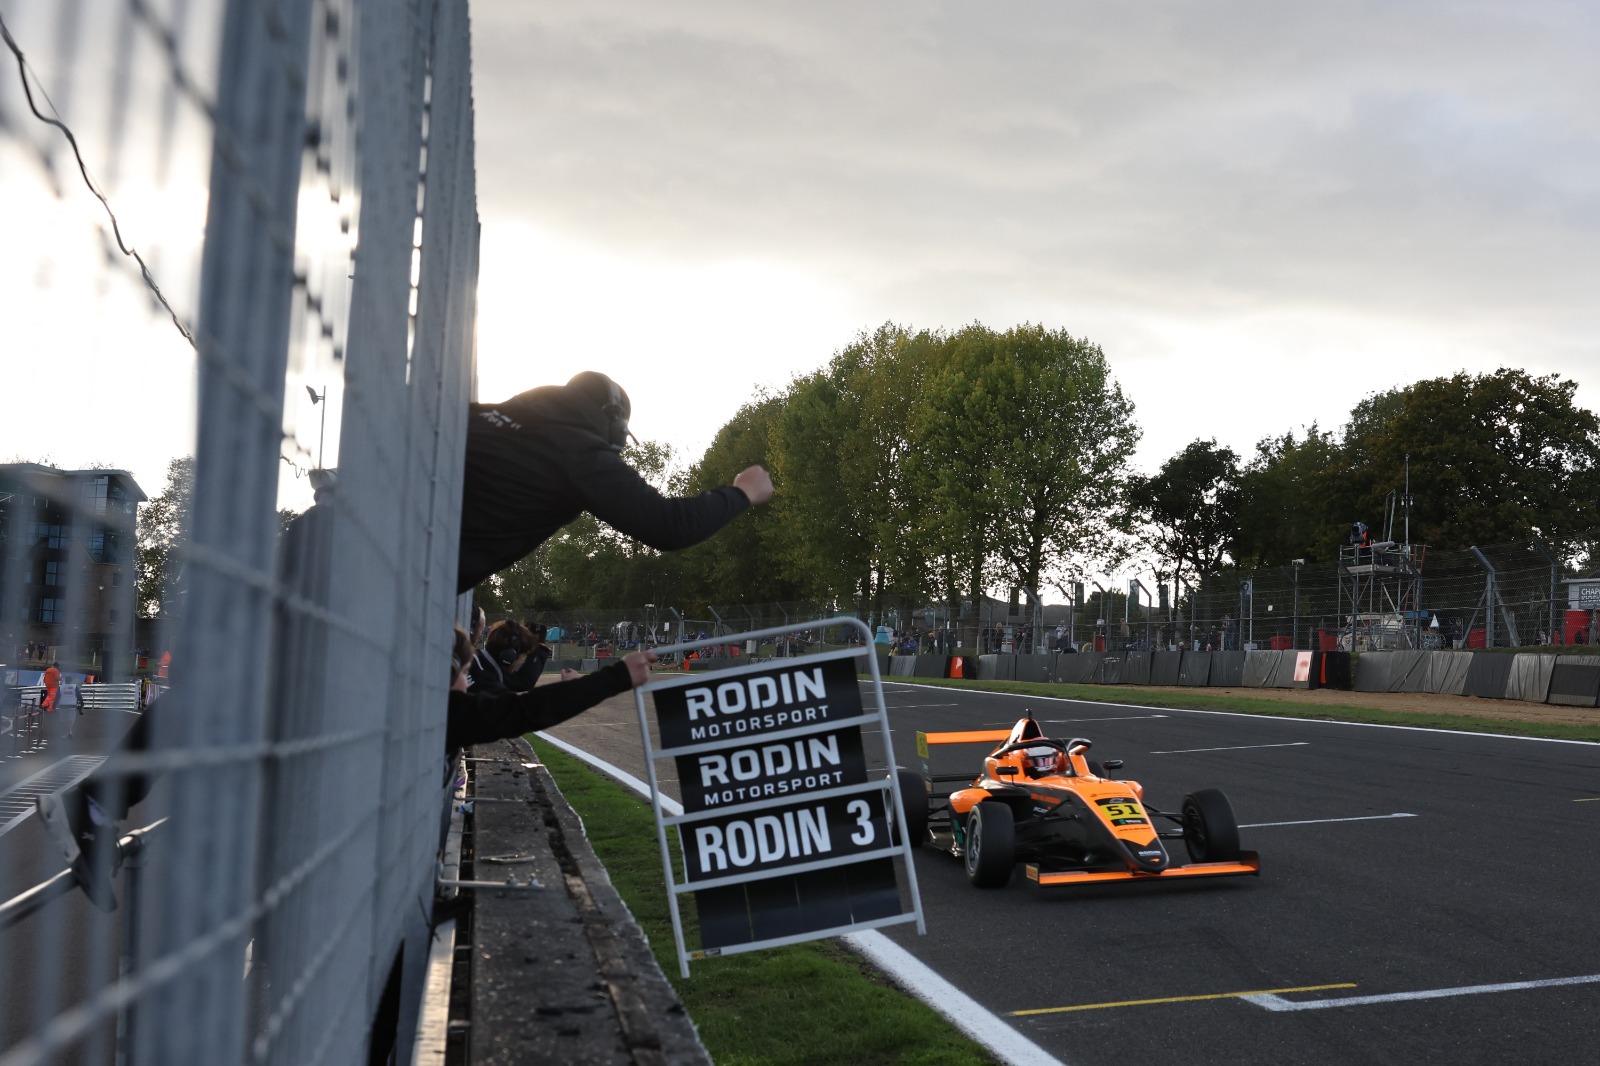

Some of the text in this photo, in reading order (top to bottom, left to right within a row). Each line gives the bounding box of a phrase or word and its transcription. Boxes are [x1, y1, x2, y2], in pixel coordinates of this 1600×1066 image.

[685, 668, 827, 720] RODIN
[691, 705, 830, 740] MOTORSPORT
[699, 735, 841, 787] RODIN
[704, 771, 844, 806] MOTORSPORT
[1106, 804, 1141, 816] 51
[695, 800, 876, 873] RODIN 3
